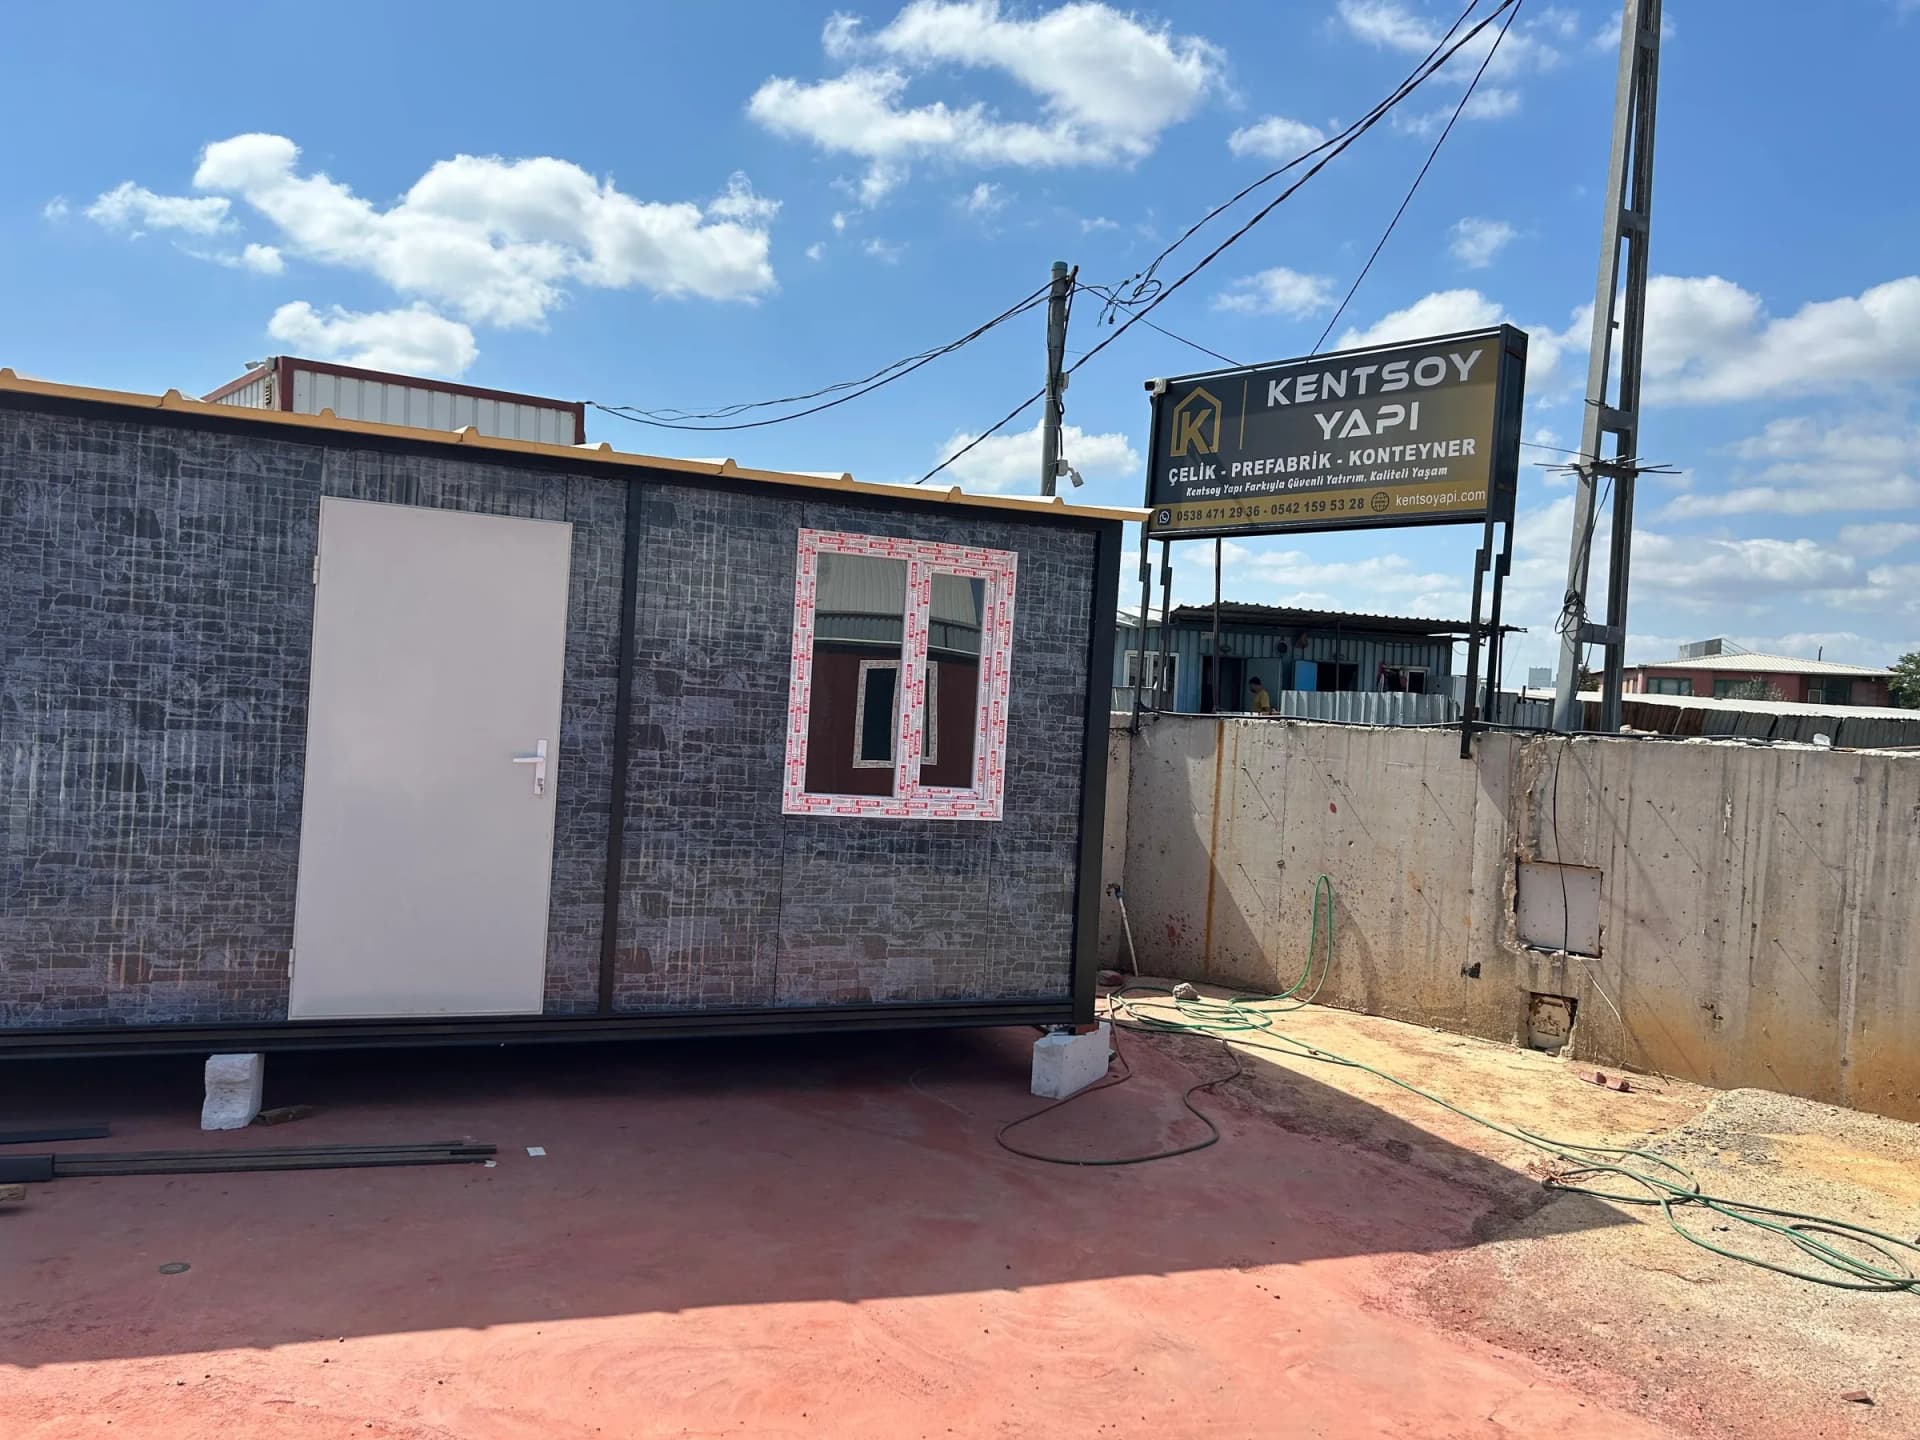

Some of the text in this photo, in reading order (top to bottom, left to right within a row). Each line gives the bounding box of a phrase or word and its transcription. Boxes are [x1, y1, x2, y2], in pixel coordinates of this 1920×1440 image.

[1267, 349, 1483, 408] KENTSOY
[1314, 402, 1419, 440] YAPI
[1168, 462, 1216, 486] ÇELİK
[1231, 450, 1332, 478] PREFABRİK
[1349, 438, 1476, 466] KONTEYNER
[1186, 484, 1221, 496] Kentsoy
[1224, 484, 1242, 494] Yapı
[1244, 480, 1285, 493] Farkıyla
[1288, 476, 1323, 488] Güvenli
[1370, 468, 1408, 481] Kaliteli
[1412, 467, 1448, 479] Yaşam
[1396, 490, 1485, 506] kentsoyapi.com
[1177, 510, 1202, 520] 0538
[1206, 509, 1224, 519] 471
[1229, 508, 1243, 518] 29
[1246, 506, 1260, 516] 36
[1271, 502, 1300, 515] 0542
[1304, 501, 1326, 512] 159
[1330, 500, 1344, 511] 53
[1349, 498, 1364, 509] 28
